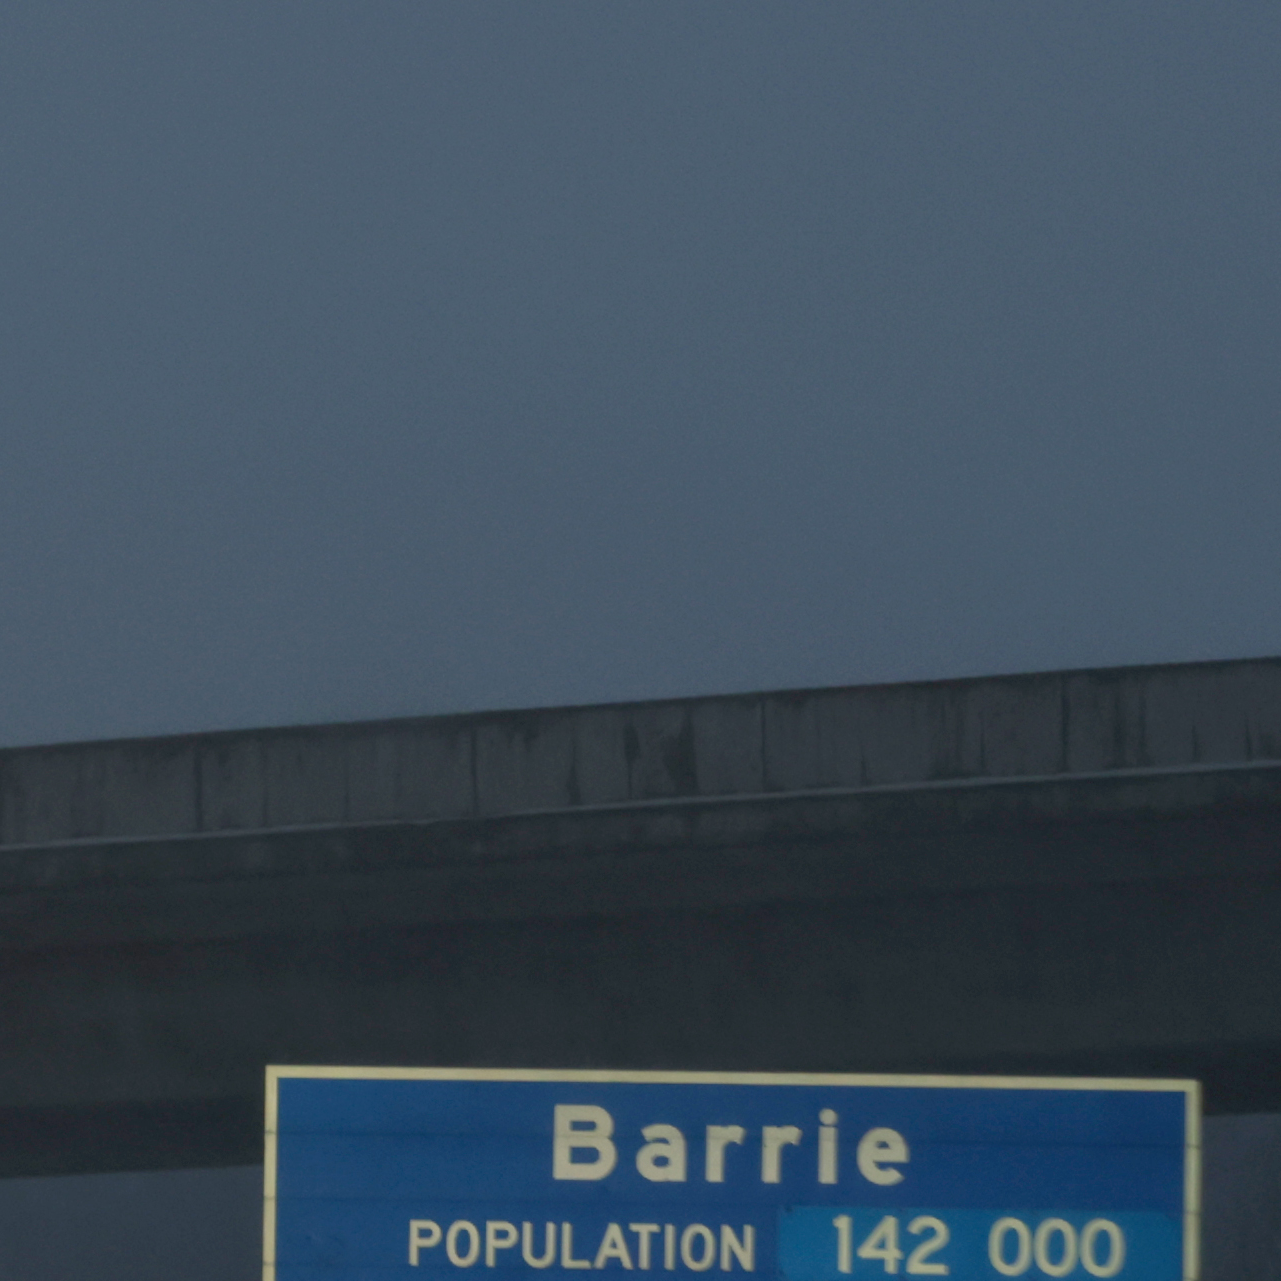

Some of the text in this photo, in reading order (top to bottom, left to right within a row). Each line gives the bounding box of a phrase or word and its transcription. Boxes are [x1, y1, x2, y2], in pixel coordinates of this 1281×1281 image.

[552, 1104, 908, 1186] Barrie
[408, 1214, 1124, 1278] POPULATION 142 000
